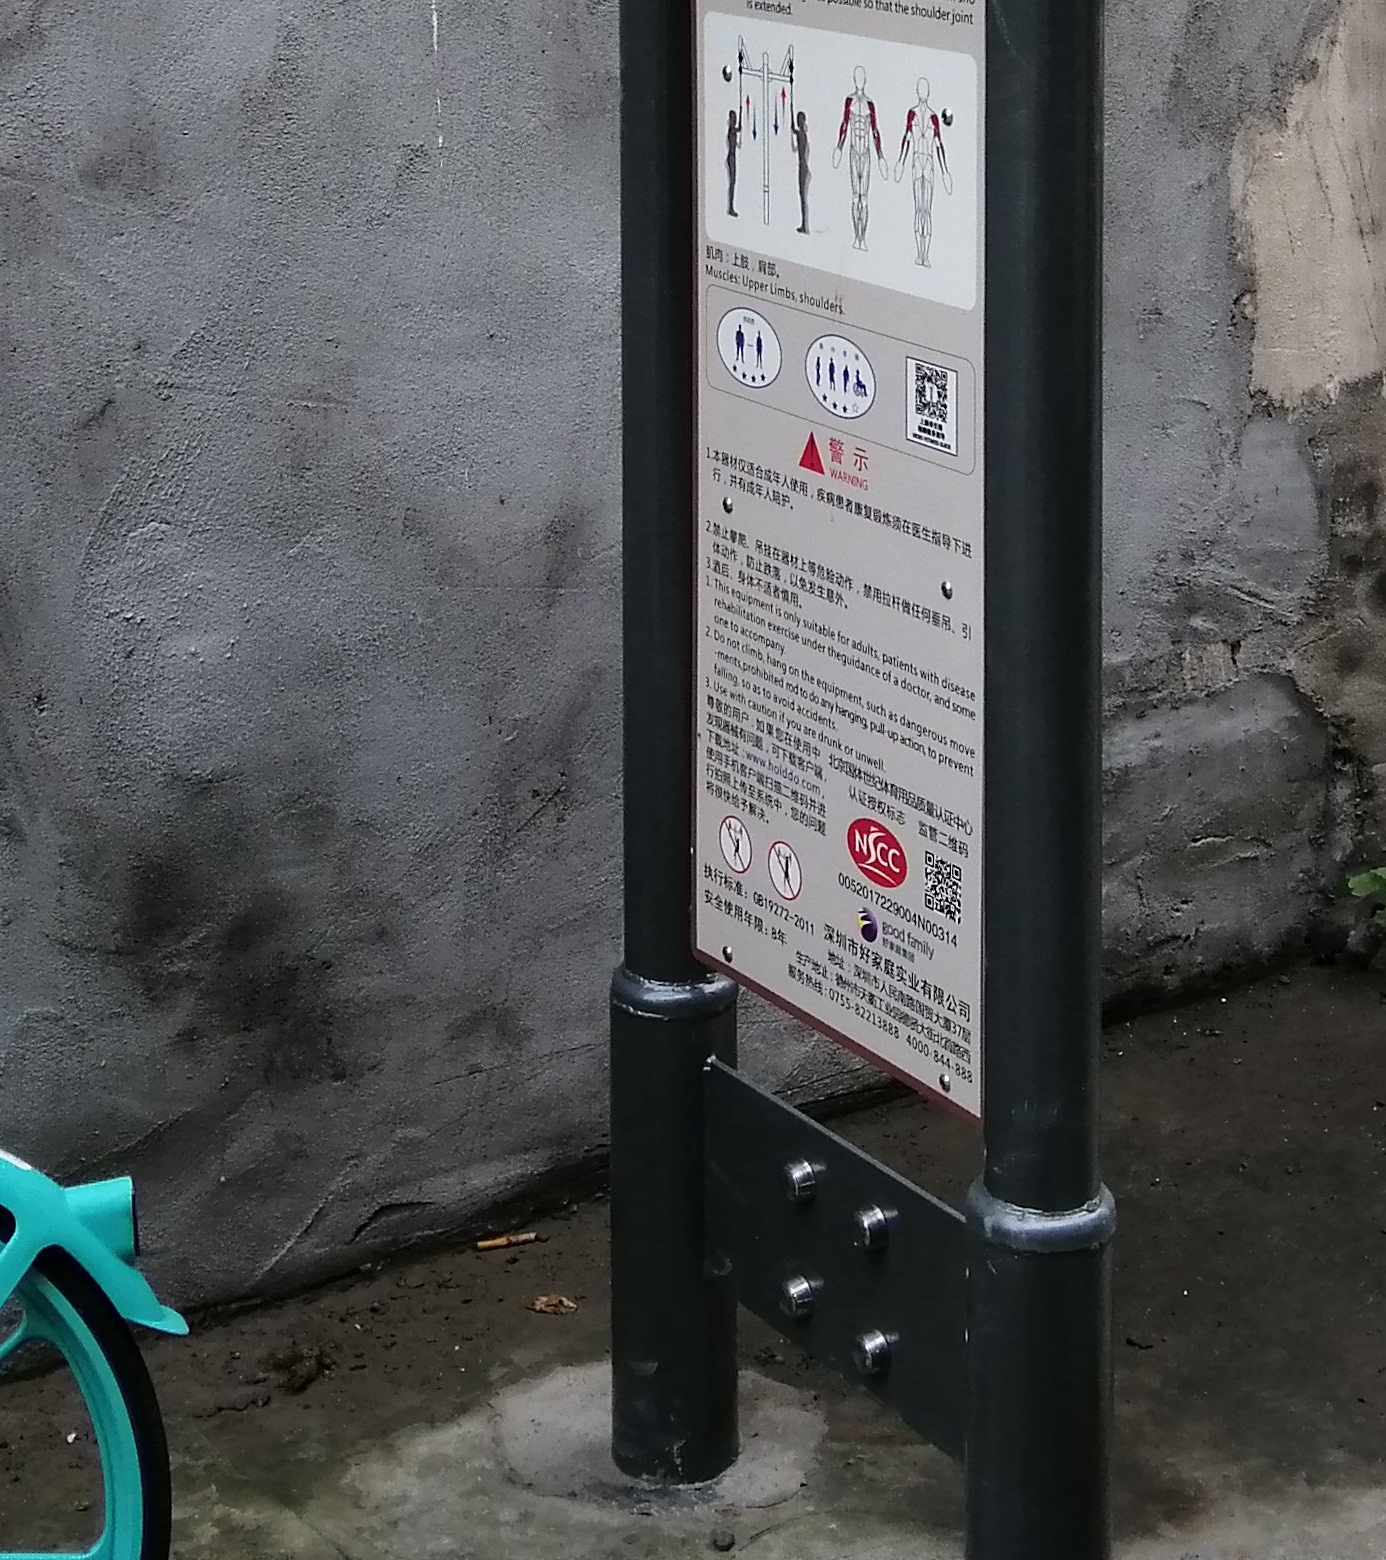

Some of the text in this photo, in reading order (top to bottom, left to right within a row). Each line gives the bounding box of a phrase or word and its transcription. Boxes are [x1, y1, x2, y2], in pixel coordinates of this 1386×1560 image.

[705, 263, 845, 316] Muscles: Upper Limbs, shoulders.
[828, 436, 870, 473] 警示
[829, 467, 869, 491] WARNING
[705, 574, 976, 702] 1. This equipment is only suitable for adults, patients with disease
[705, 624, 975, 759] 2. Do not climb, hang on the equipment, such as dangerous move
[705, 675, 886, 773] 3. Use with caution if you are drunk or unwell.
[854, 826, 901, 874] NSCC
[752, 890, 814, 936] GB19272-2011
[837, 871, 957, 948] 0052017229004N00314
[823, 922, 970, 1023] 深圳市好家庭实业有限公司
